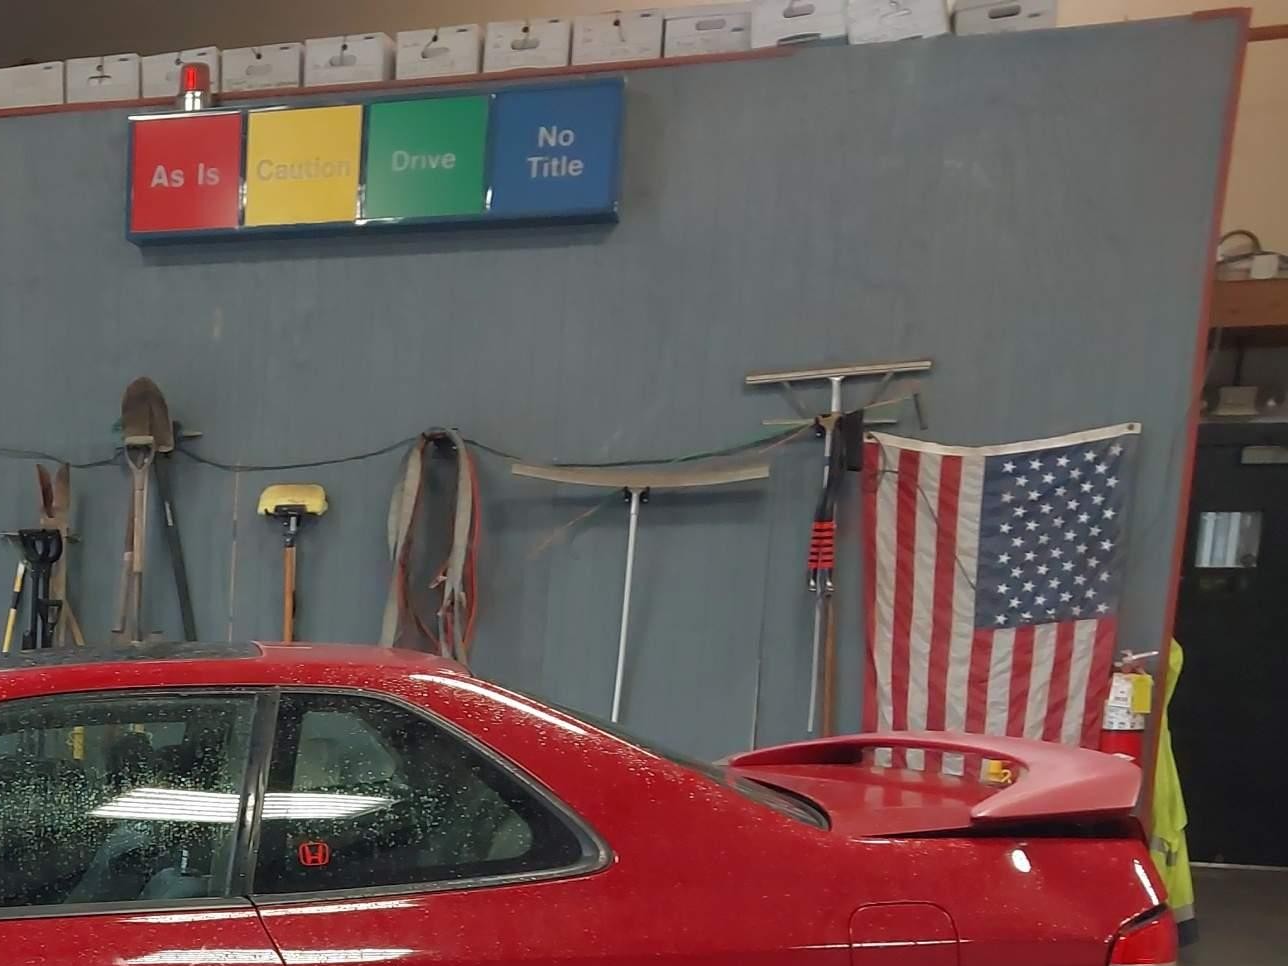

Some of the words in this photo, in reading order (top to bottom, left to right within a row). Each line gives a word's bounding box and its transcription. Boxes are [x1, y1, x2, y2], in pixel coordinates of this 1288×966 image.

[538, 125, 575, 148] No
[257, 156, 351, 181] Caution
[392, 150, 457, 172] Drive
[528, 154, 584, 178] Title
[151, 165, 184, 188] As
[198, 162, 220, 185] Is
